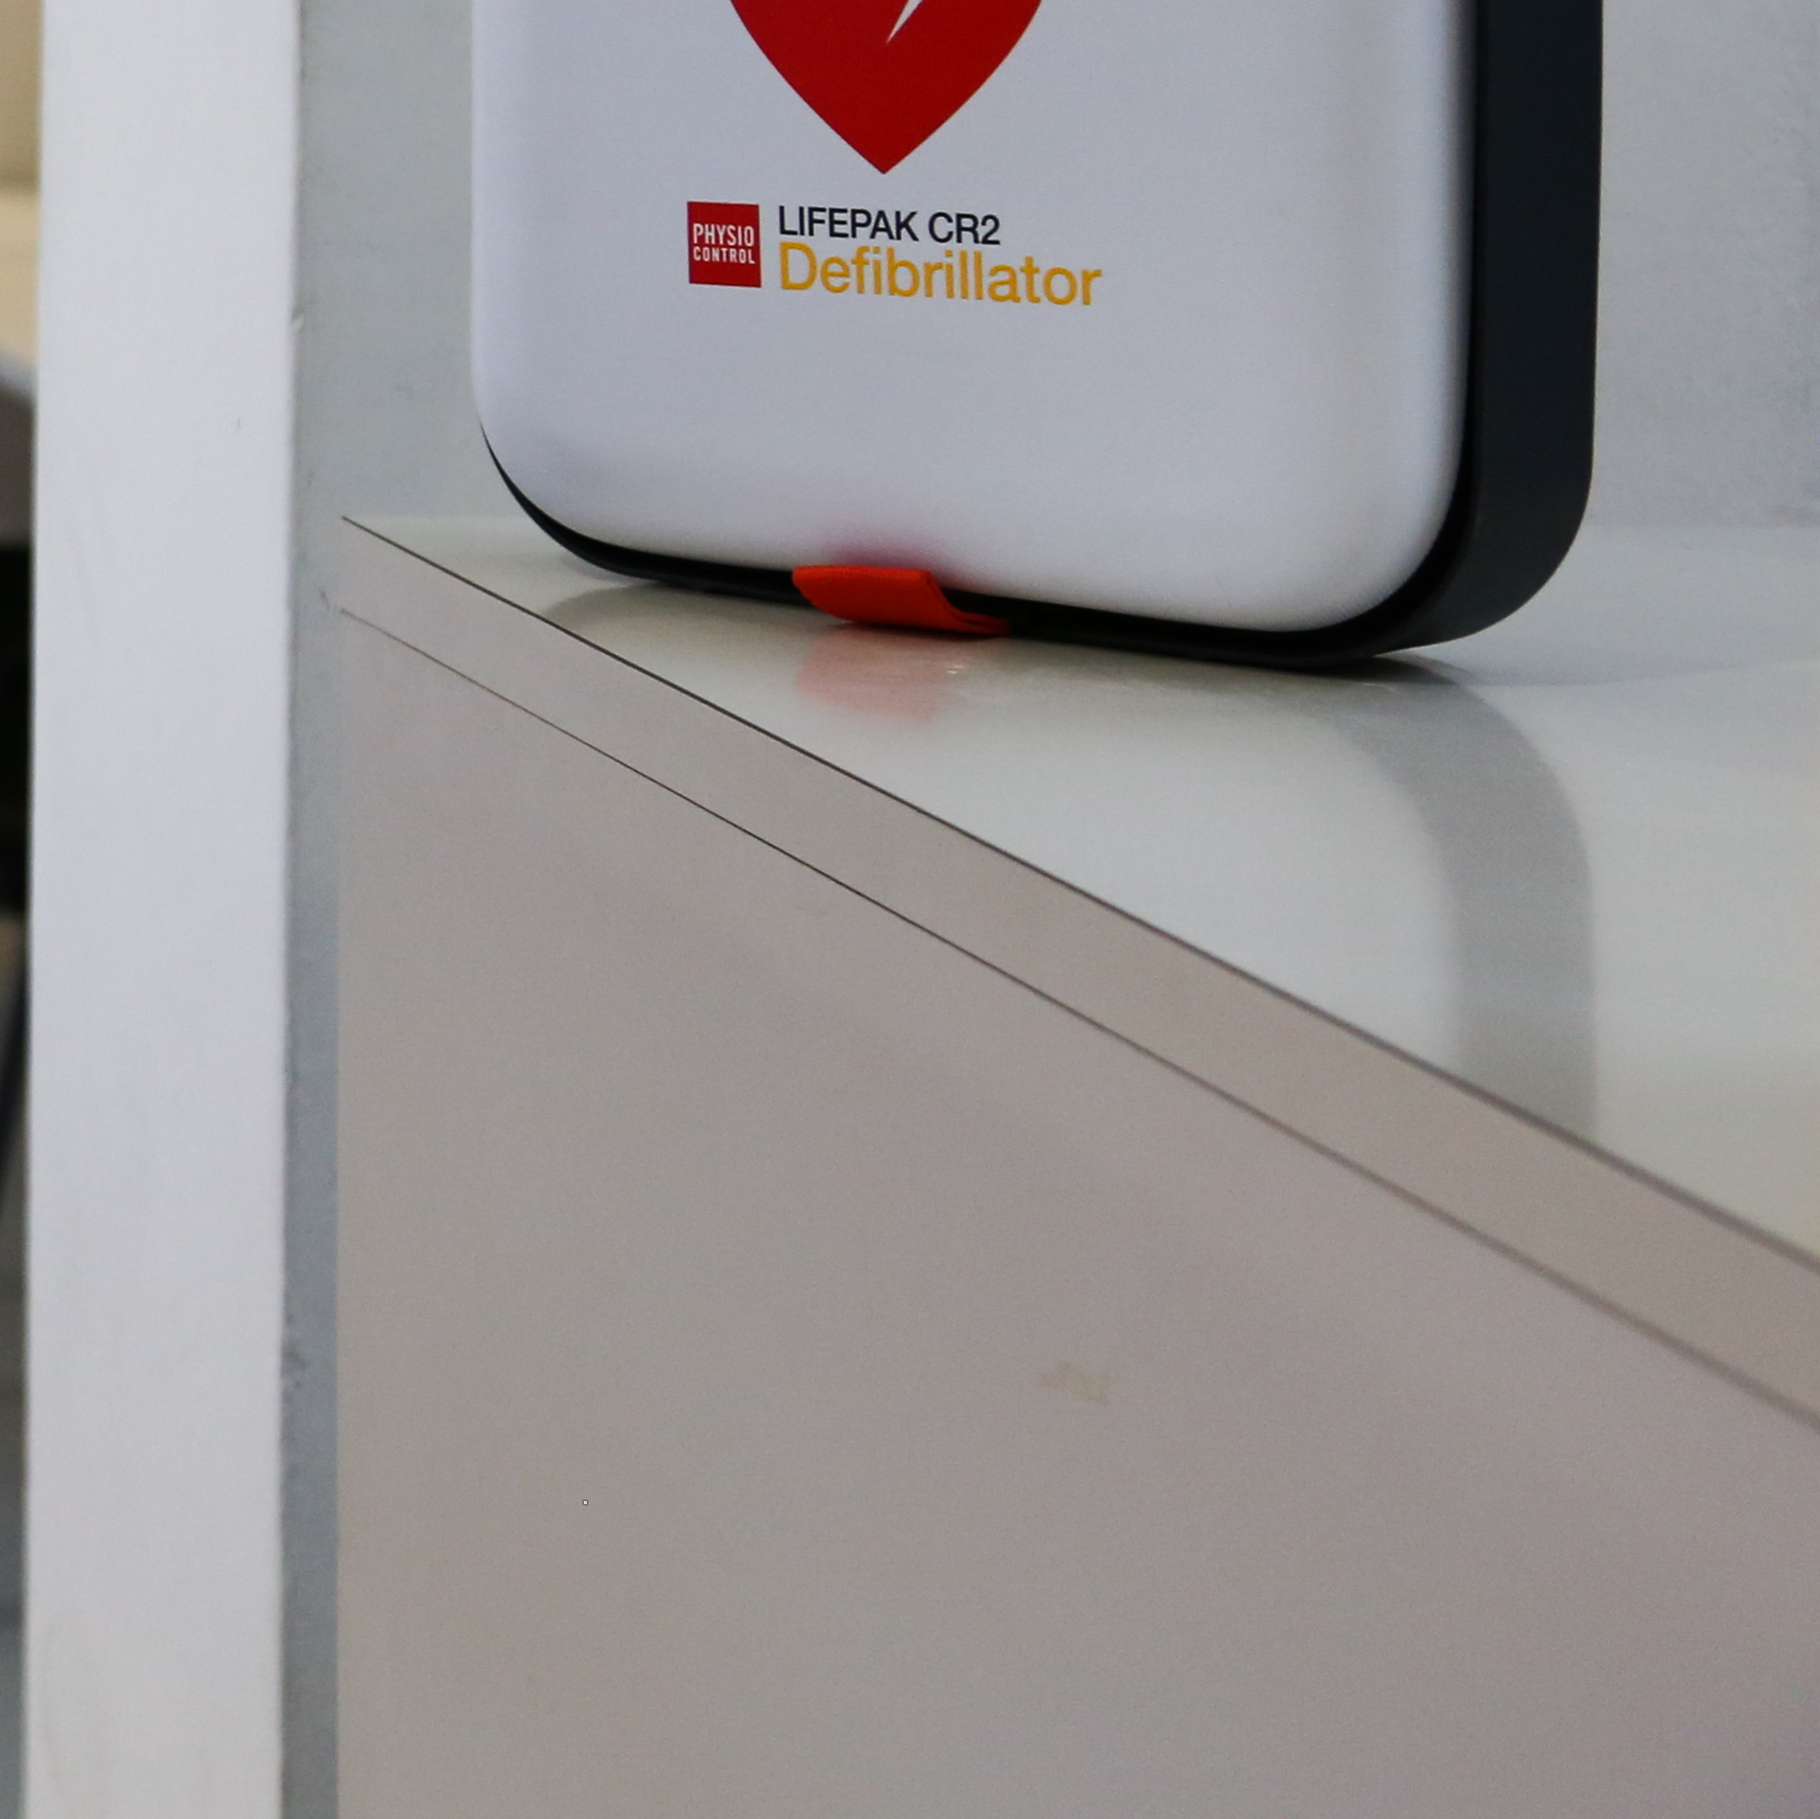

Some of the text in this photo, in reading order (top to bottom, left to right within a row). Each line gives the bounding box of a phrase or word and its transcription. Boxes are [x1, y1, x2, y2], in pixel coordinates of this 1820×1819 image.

[692, 222, 755, 247] PHYSIO
[779, 205, 1002, 246] LIFEPAK CR2
[693, 245, 756, 265] CONTROL
[780, 241, 1104, 307] Defibrillator
